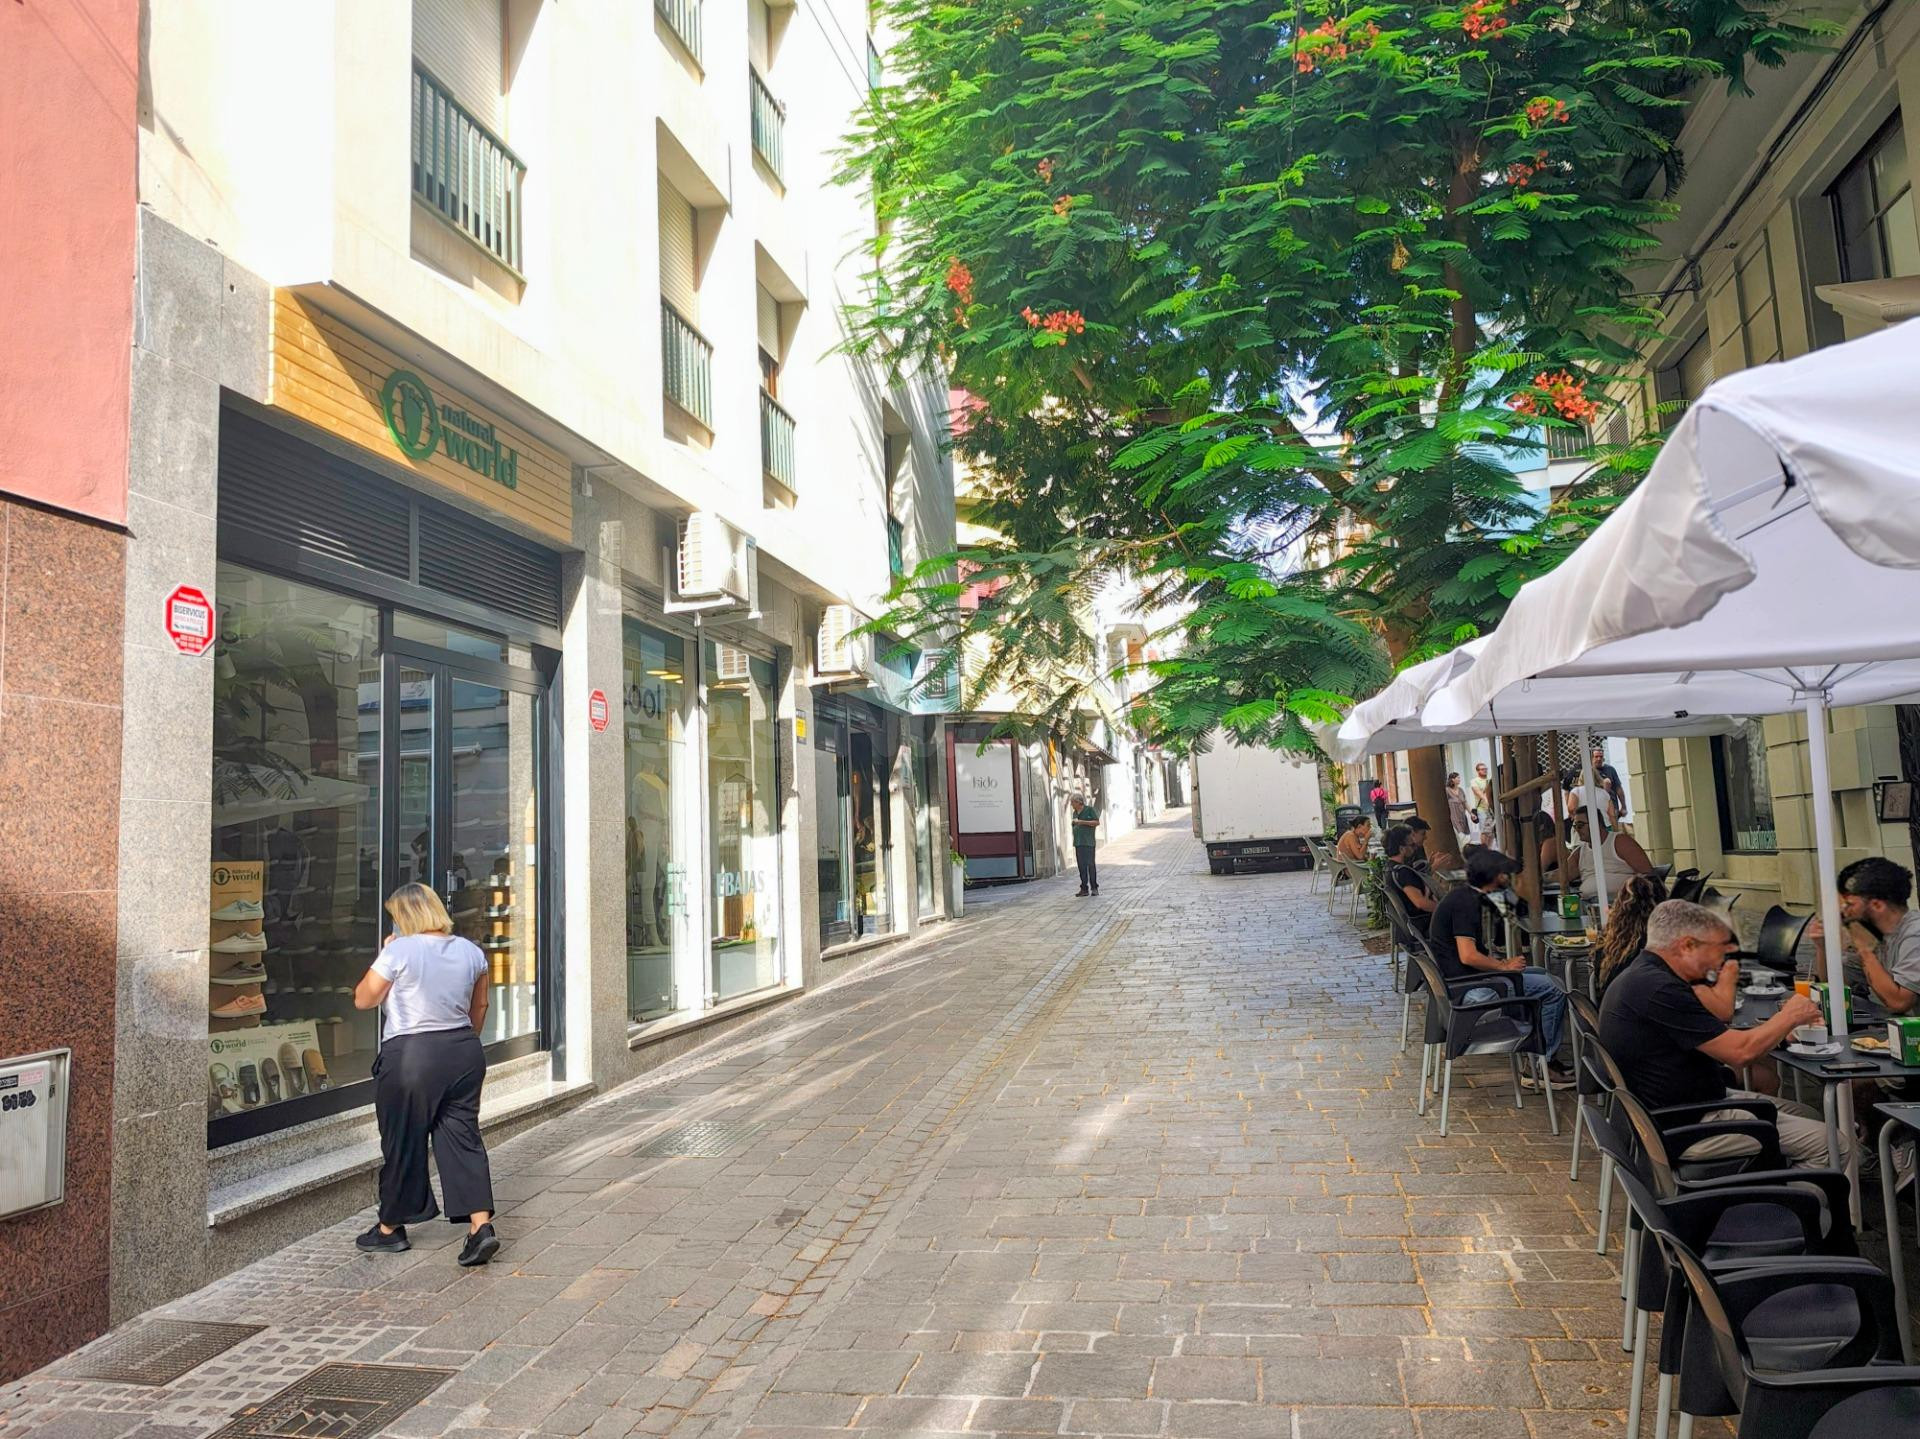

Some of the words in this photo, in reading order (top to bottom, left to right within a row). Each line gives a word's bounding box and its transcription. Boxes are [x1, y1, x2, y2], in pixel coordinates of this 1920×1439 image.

[441, 404, 496, 447] natural
[442, 426, 518, 490] world
[232, 871, 260, 881] world
